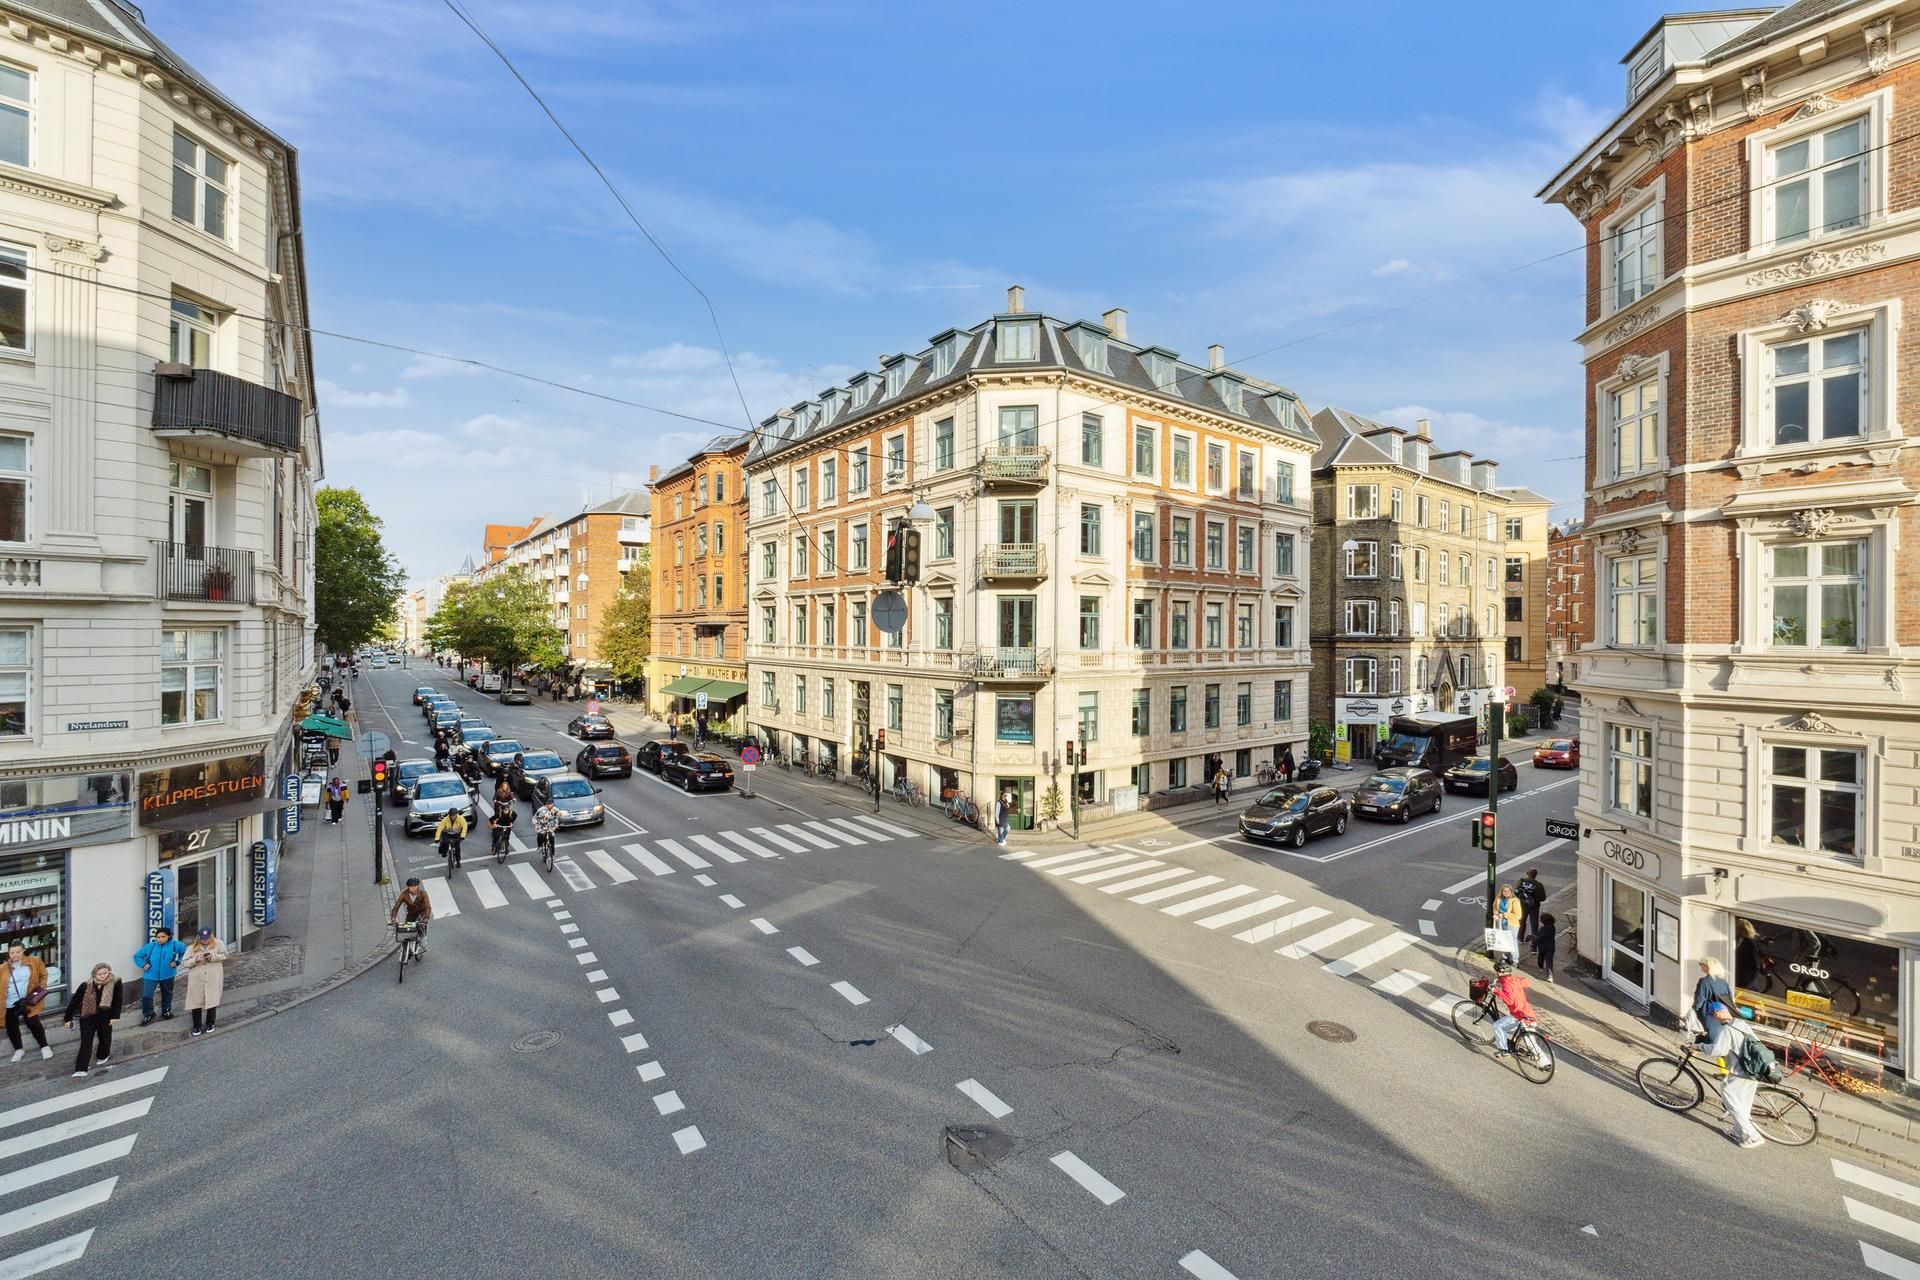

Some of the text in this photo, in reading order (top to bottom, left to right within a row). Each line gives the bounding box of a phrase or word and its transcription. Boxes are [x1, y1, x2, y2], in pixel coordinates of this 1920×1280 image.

[71, 721, 127, 731] Nyelandsvej
[143, 775, 263, 811] KLIPPESTUEN
[287, 778, 298, 832] KLIPPSTUEN
[187, 828, 212, 851] 27
[254, 844, 266, 925] KLIPPESTUEN
